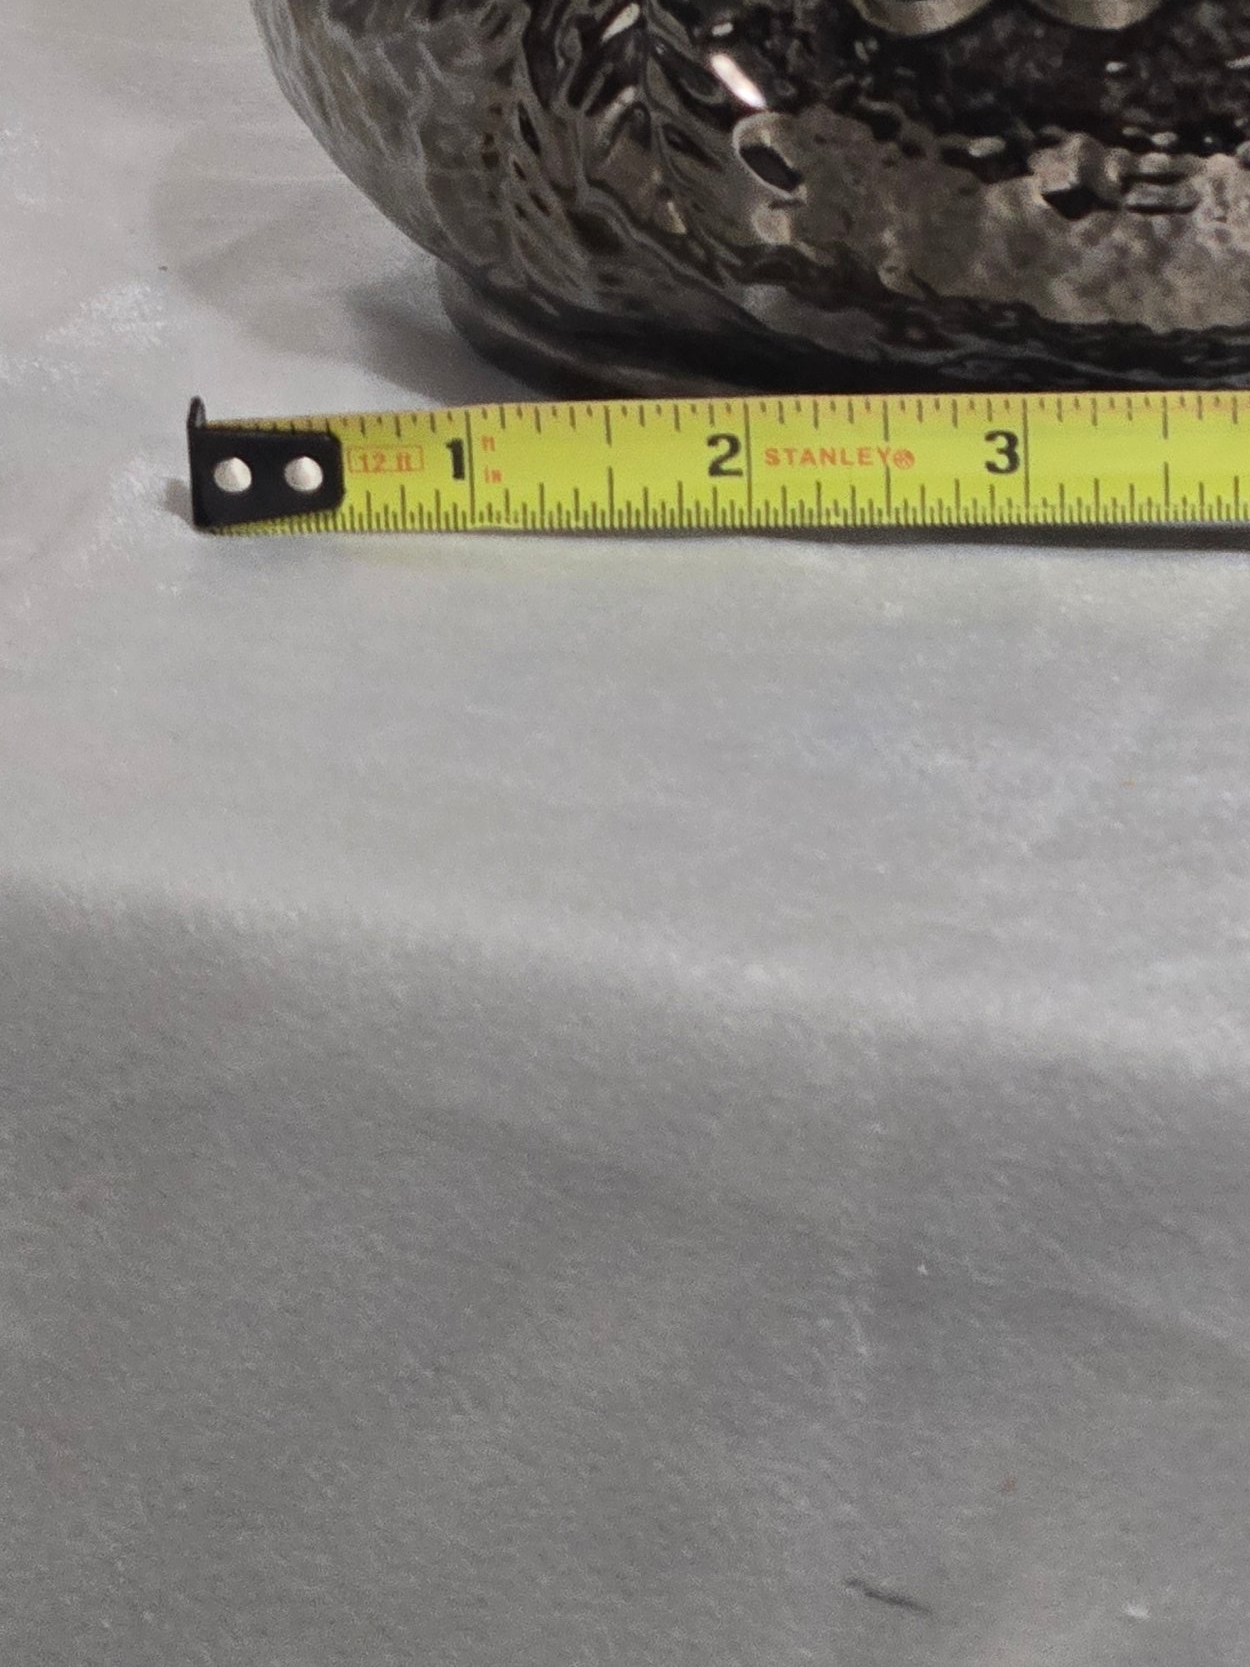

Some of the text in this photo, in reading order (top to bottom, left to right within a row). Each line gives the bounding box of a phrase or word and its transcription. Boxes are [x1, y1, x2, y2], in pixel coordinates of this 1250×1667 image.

[446, 437, 466, 481] 1
[706, 433, 743, 477] 2
[984, 429, 1020, 474] 3
